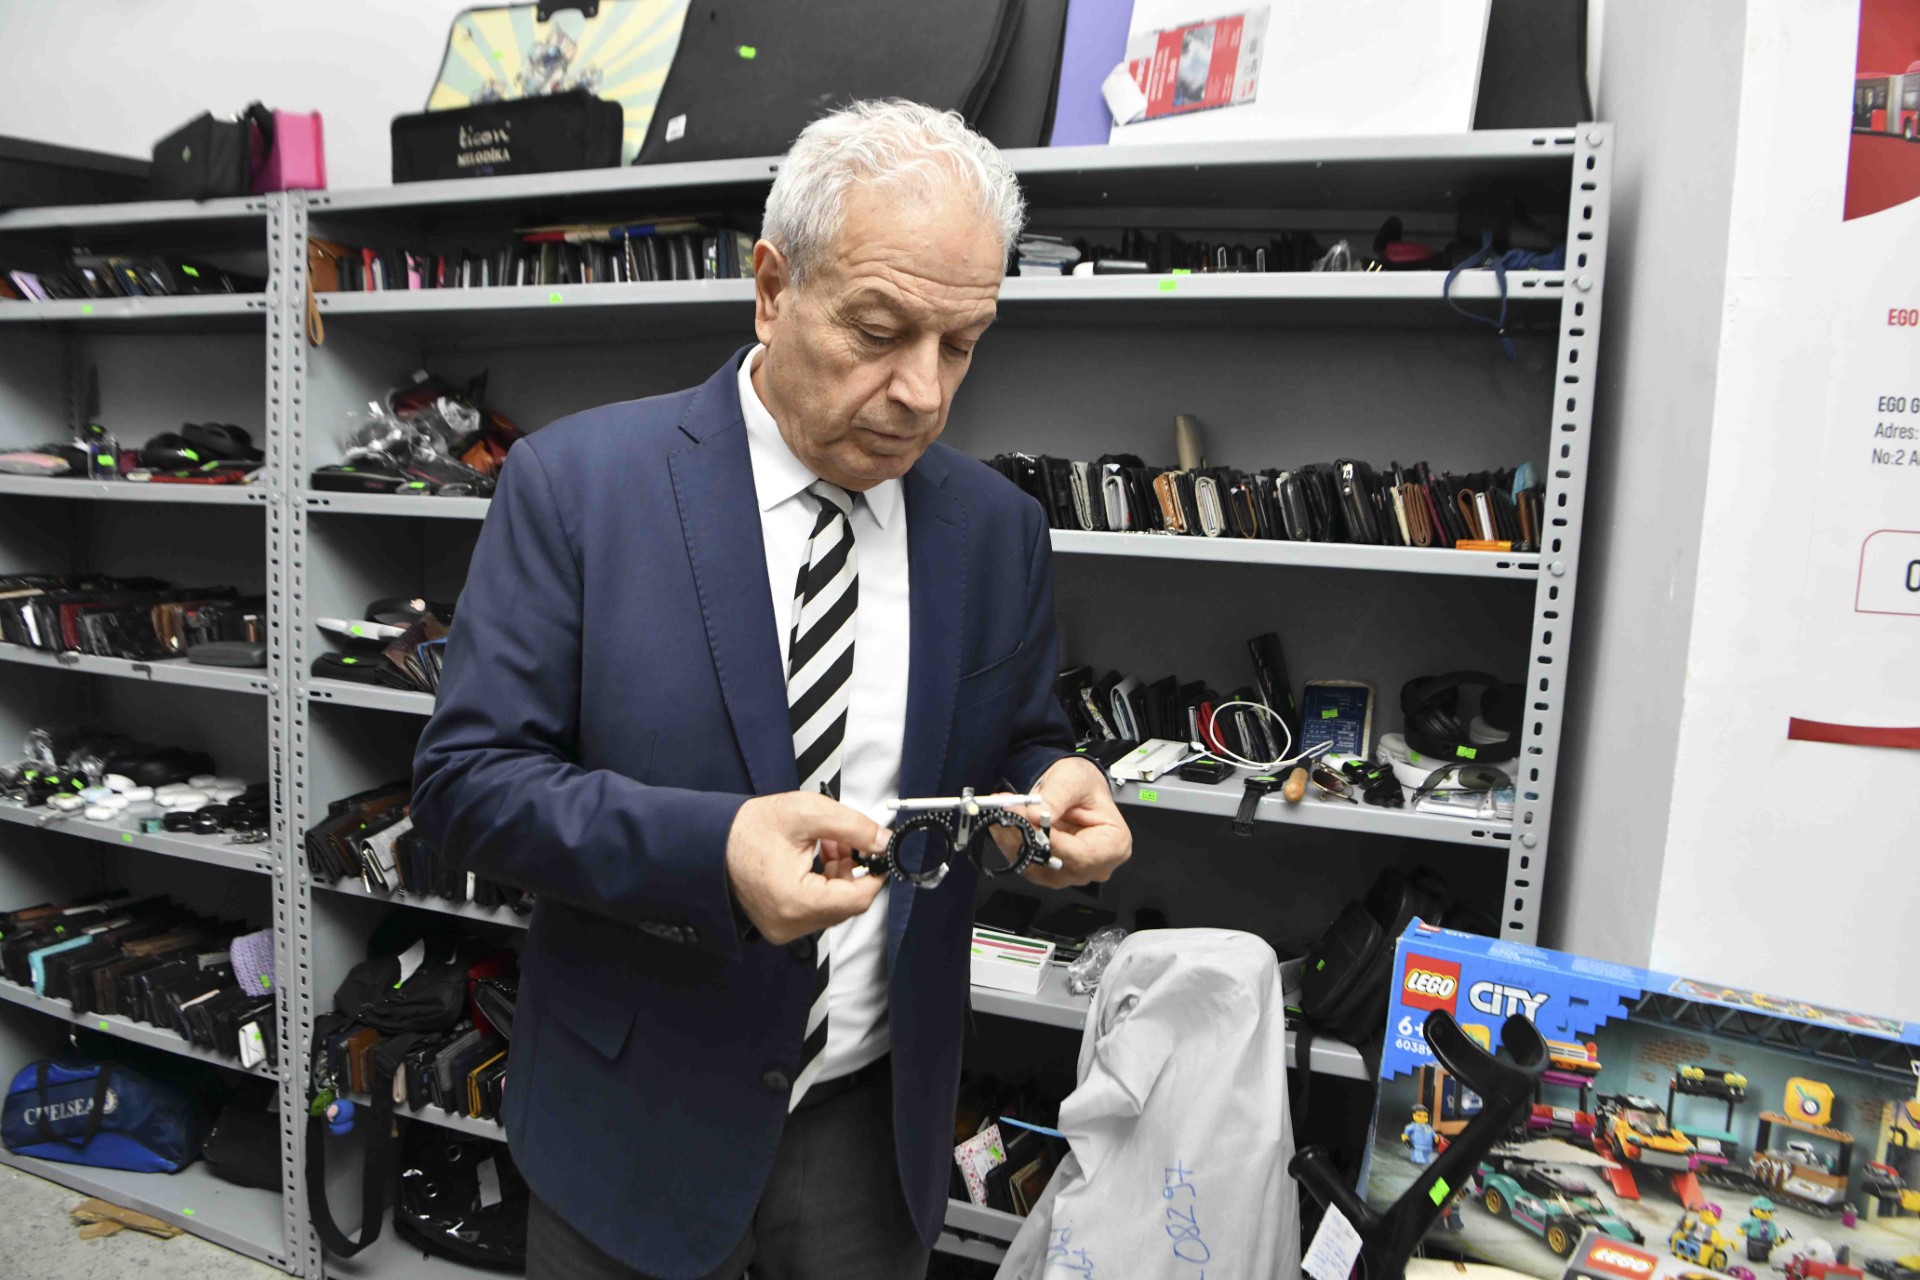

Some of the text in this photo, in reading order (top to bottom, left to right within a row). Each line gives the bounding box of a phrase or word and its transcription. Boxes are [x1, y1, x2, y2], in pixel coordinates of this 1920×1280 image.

[1888, 308, 1919, 327] EGO
[1878, 396, 1906, 413] EGO
[1874, 422, 1919, 440] Adres:
[1872, 448, 1920, 467] No:2 A
[1405, 970, 1551, 1024] LEGO CITY
